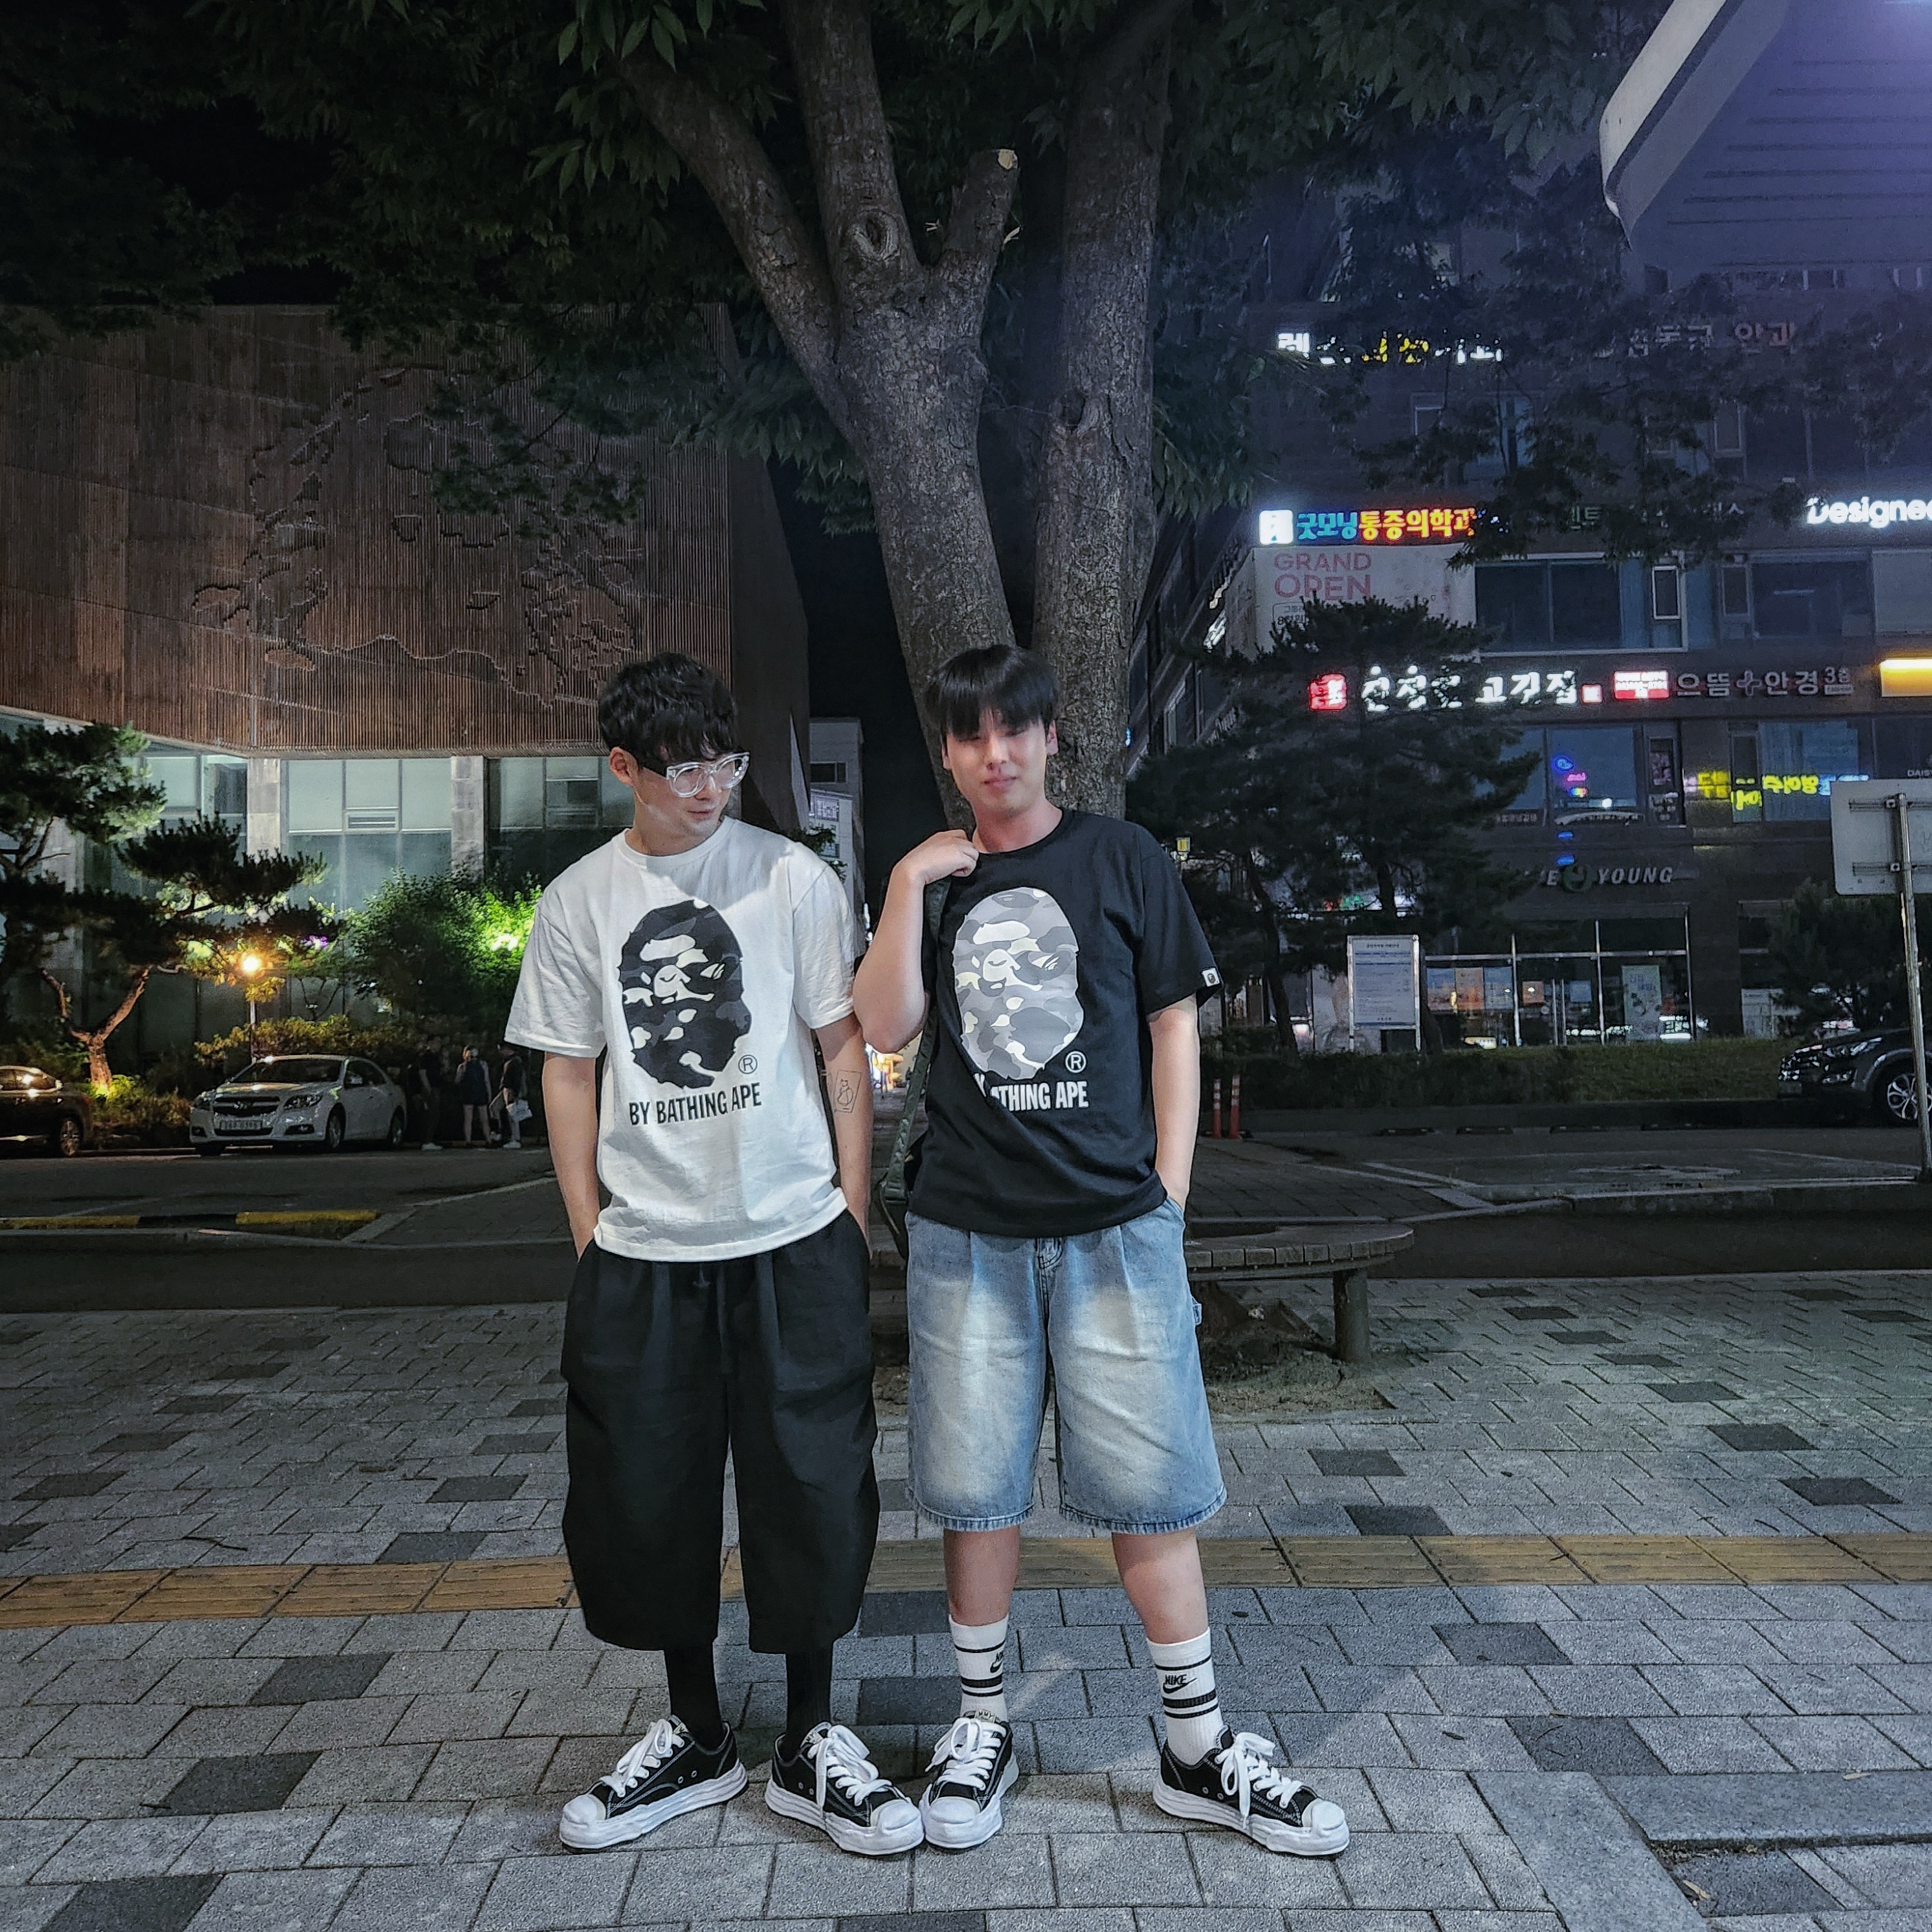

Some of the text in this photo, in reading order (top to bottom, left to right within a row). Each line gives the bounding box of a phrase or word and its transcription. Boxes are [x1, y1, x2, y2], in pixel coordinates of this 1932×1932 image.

[1805, 496, 1932, 528] Designe
[1274, 553, 1371, 572] GRAND
[1274, 574, 1371, 601] OPEN
[1598, 867, 1673, 884] YOUNG
[628, 1082, 762, 1126] BY BATHING APE
[991, 1082, 1051, 1111] THING
[1056, 1081, 1089, 1109] APE
[1165, 1674, 1187, 1685] NIKE
